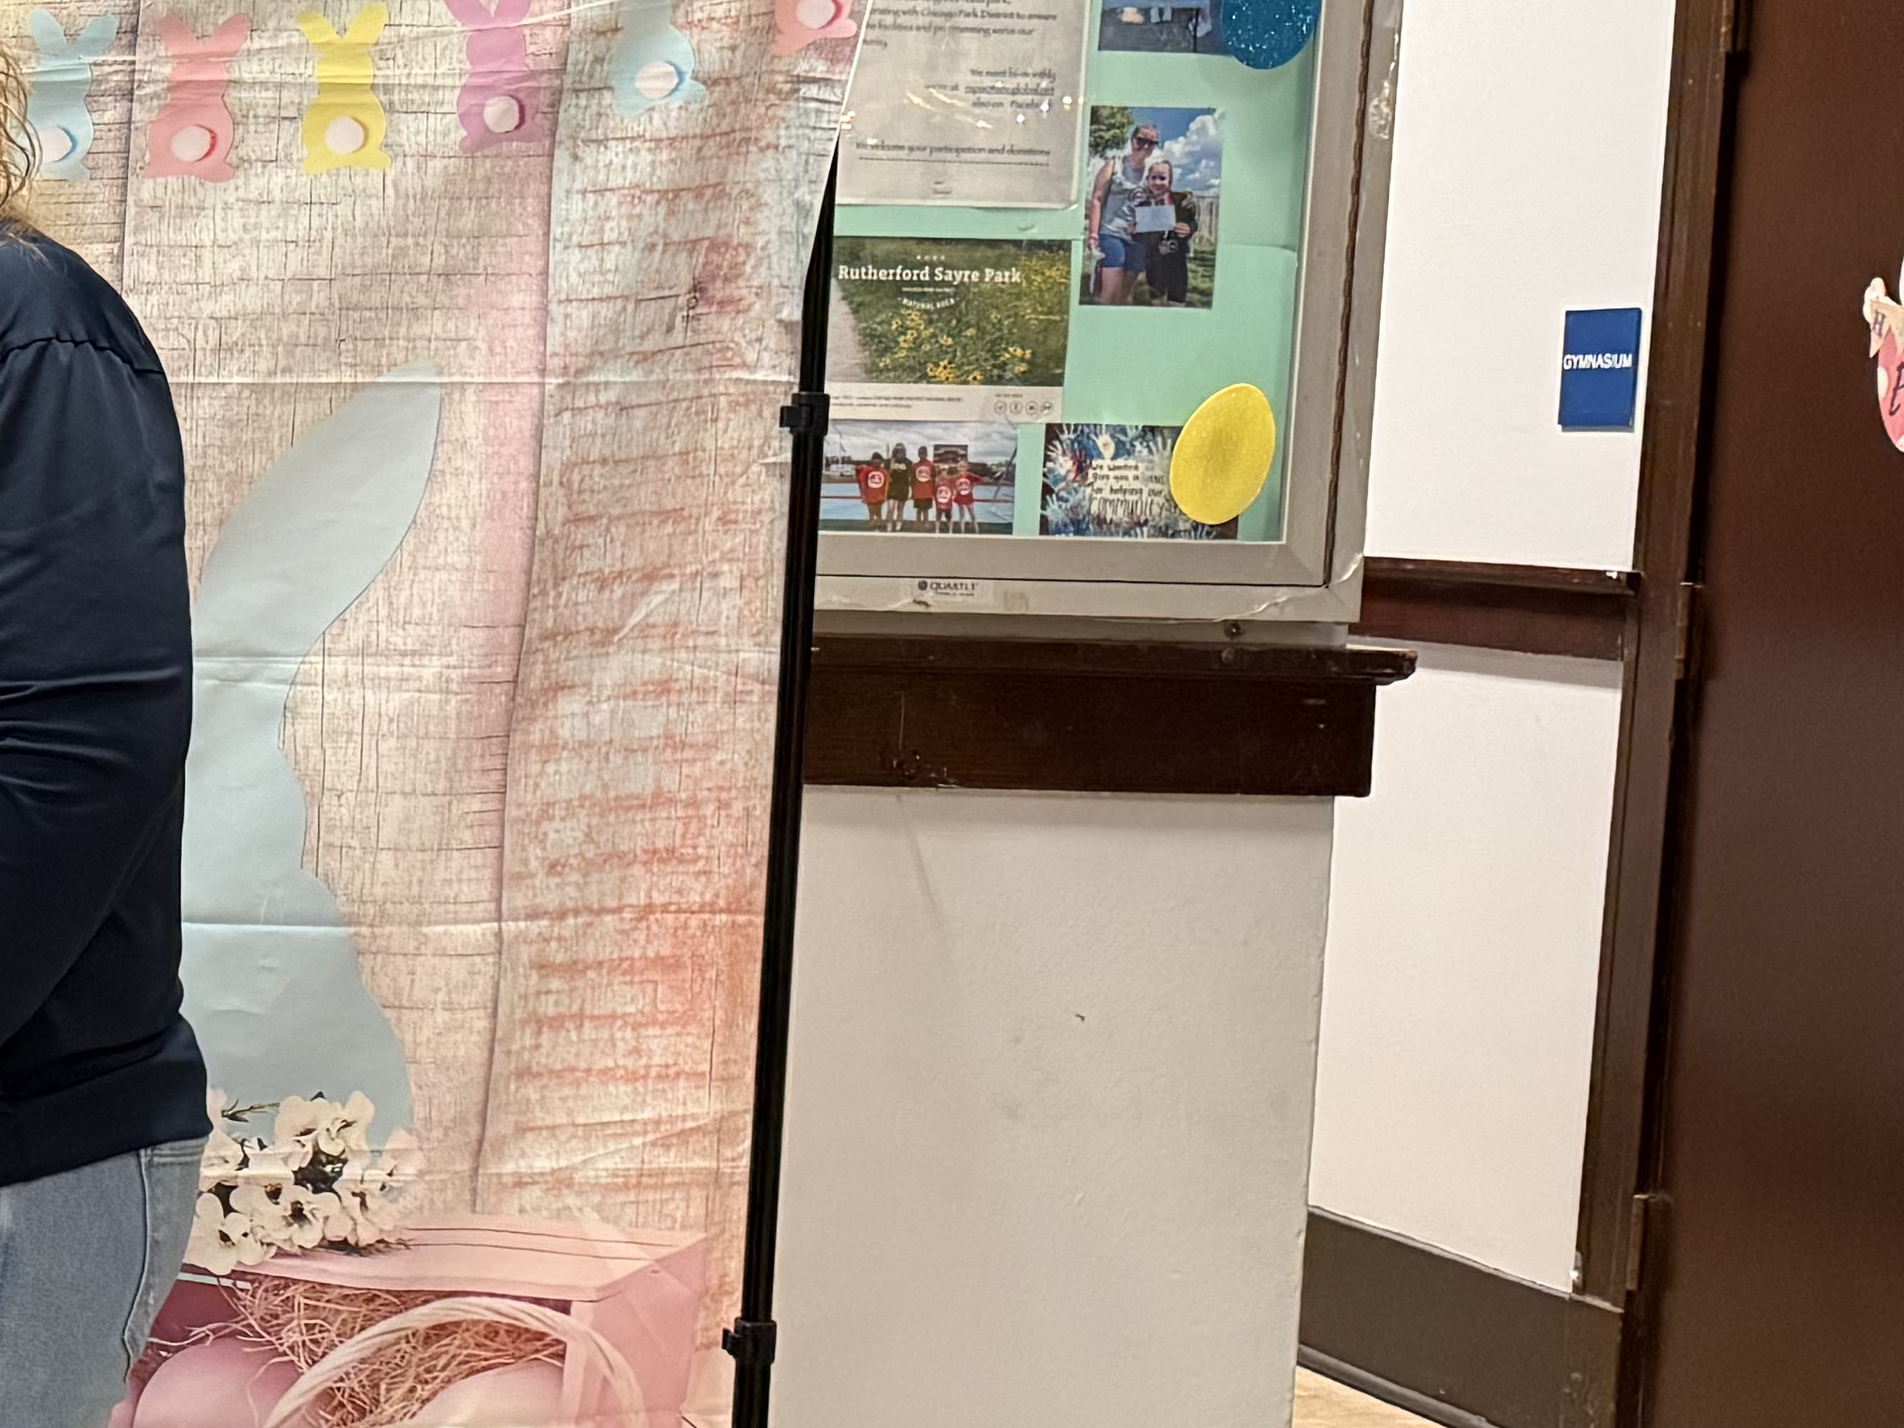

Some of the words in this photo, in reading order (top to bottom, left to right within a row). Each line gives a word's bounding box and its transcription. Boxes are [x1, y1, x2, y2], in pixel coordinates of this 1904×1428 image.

[838, 264, 930, 283] Rutherford
[934, 266, 980, 285] Sayre
[984, 268, 1022, 284] Park
[1563, 353, 1633, 370] GYMNASIUM
